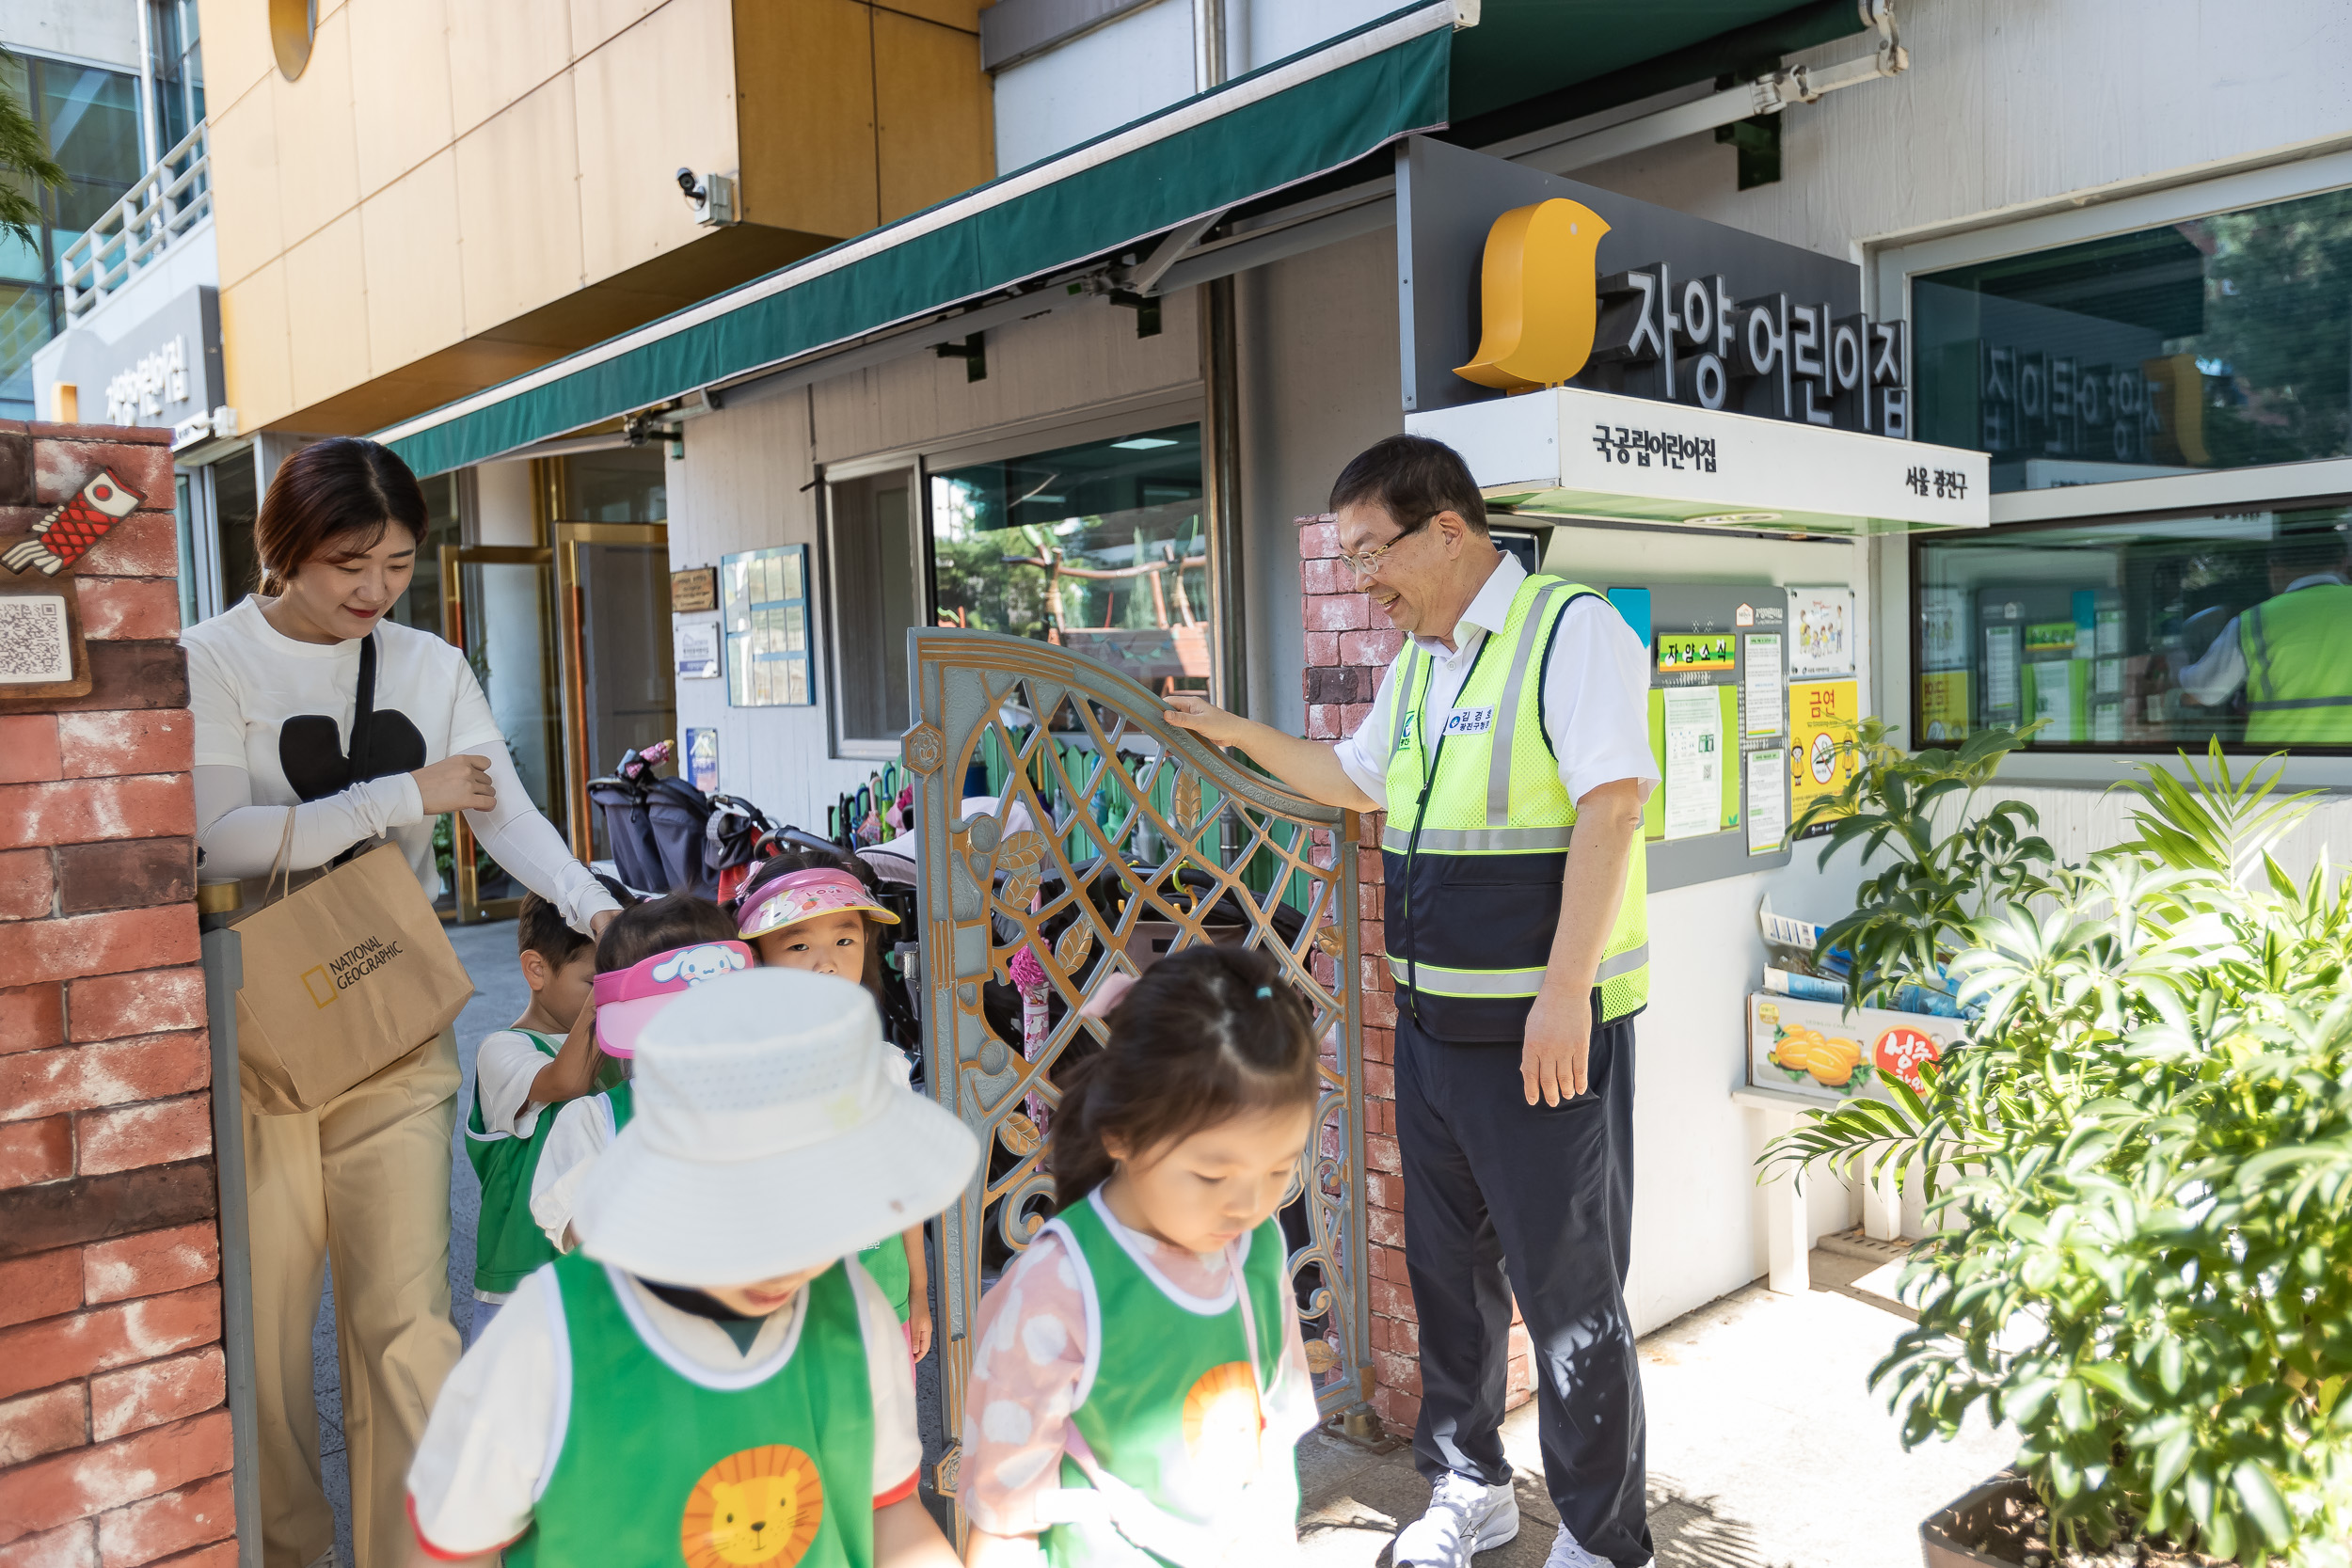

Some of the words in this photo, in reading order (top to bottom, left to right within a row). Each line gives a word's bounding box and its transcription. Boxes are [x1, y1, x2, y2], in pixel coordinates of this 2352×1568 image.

[1627, 261, 1734, 411] 자양
[1746, 291, 1907, 439] 어린이집
[1592, 424, 1717, 473] 국공립어린이집
[1905, 466, 1931, 497] 서울
[1932, 468, 1968, 500] 광진구
[1809, 689, 1836, 719] 금연
[329, 935, 384, 975] NATIONAL
[336, 941, 404, 990] GEOGRAPHIC
[1883, 1031, 1933, 1070] 성주
